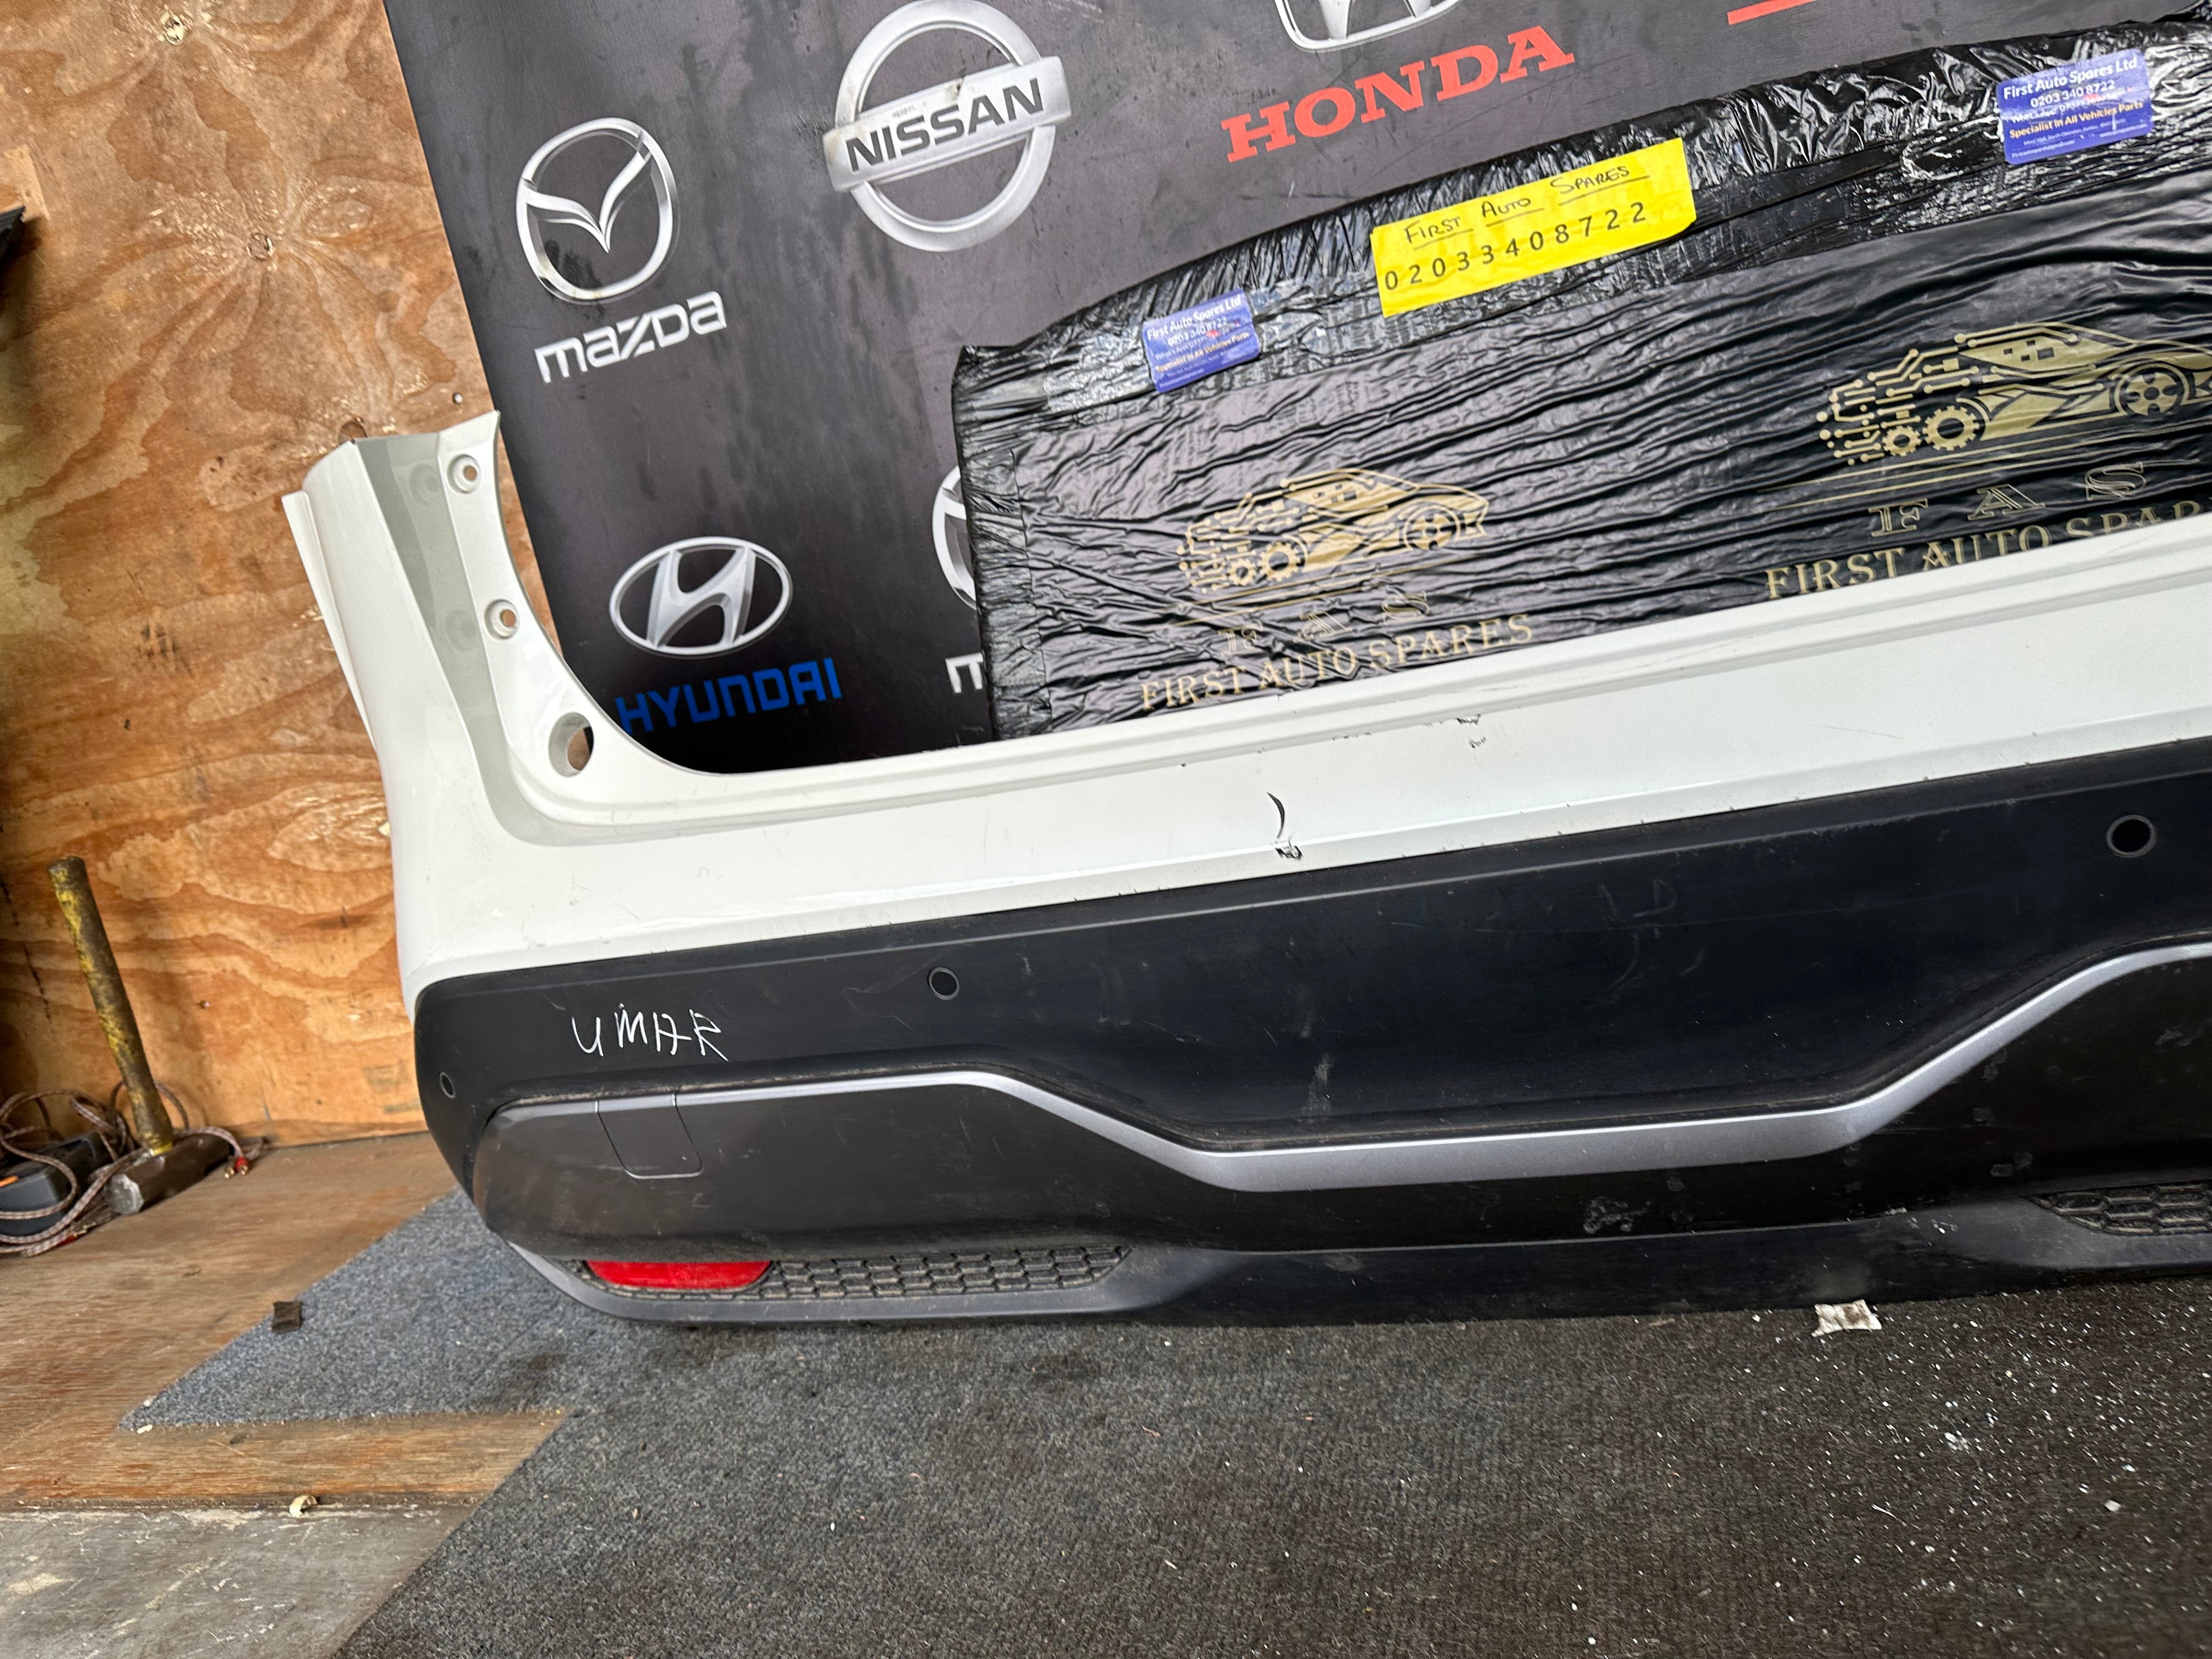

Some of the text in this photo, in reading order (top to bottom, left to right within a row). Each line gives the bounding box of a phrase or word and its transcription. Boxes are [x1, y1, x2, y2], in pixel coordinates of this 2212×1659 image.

[1222, 26, 1575, 162] HONDA
[2004, 56, 2137, 100] First Auto Spares Ltd
[2030, 92, 2060, 108] 0203
[2084, 80, 2116, 95] 8722
[847, 77, 1044, 172] NISSAN
[2065, 116, 2078, 125] All
[1170, 317, 1192, 332] Auto
[1193, 303, 1225, 321] Spares
[1224, 295, 1242, 308] Ltd
[1765, 548, 1905, 600] FIRST
[1921, 524, 2053, 571] AUTO
[614, 657, 842, 735] HYUNDAI
[1141, 614, 1534, 711] FIRST AUTO SPARES
